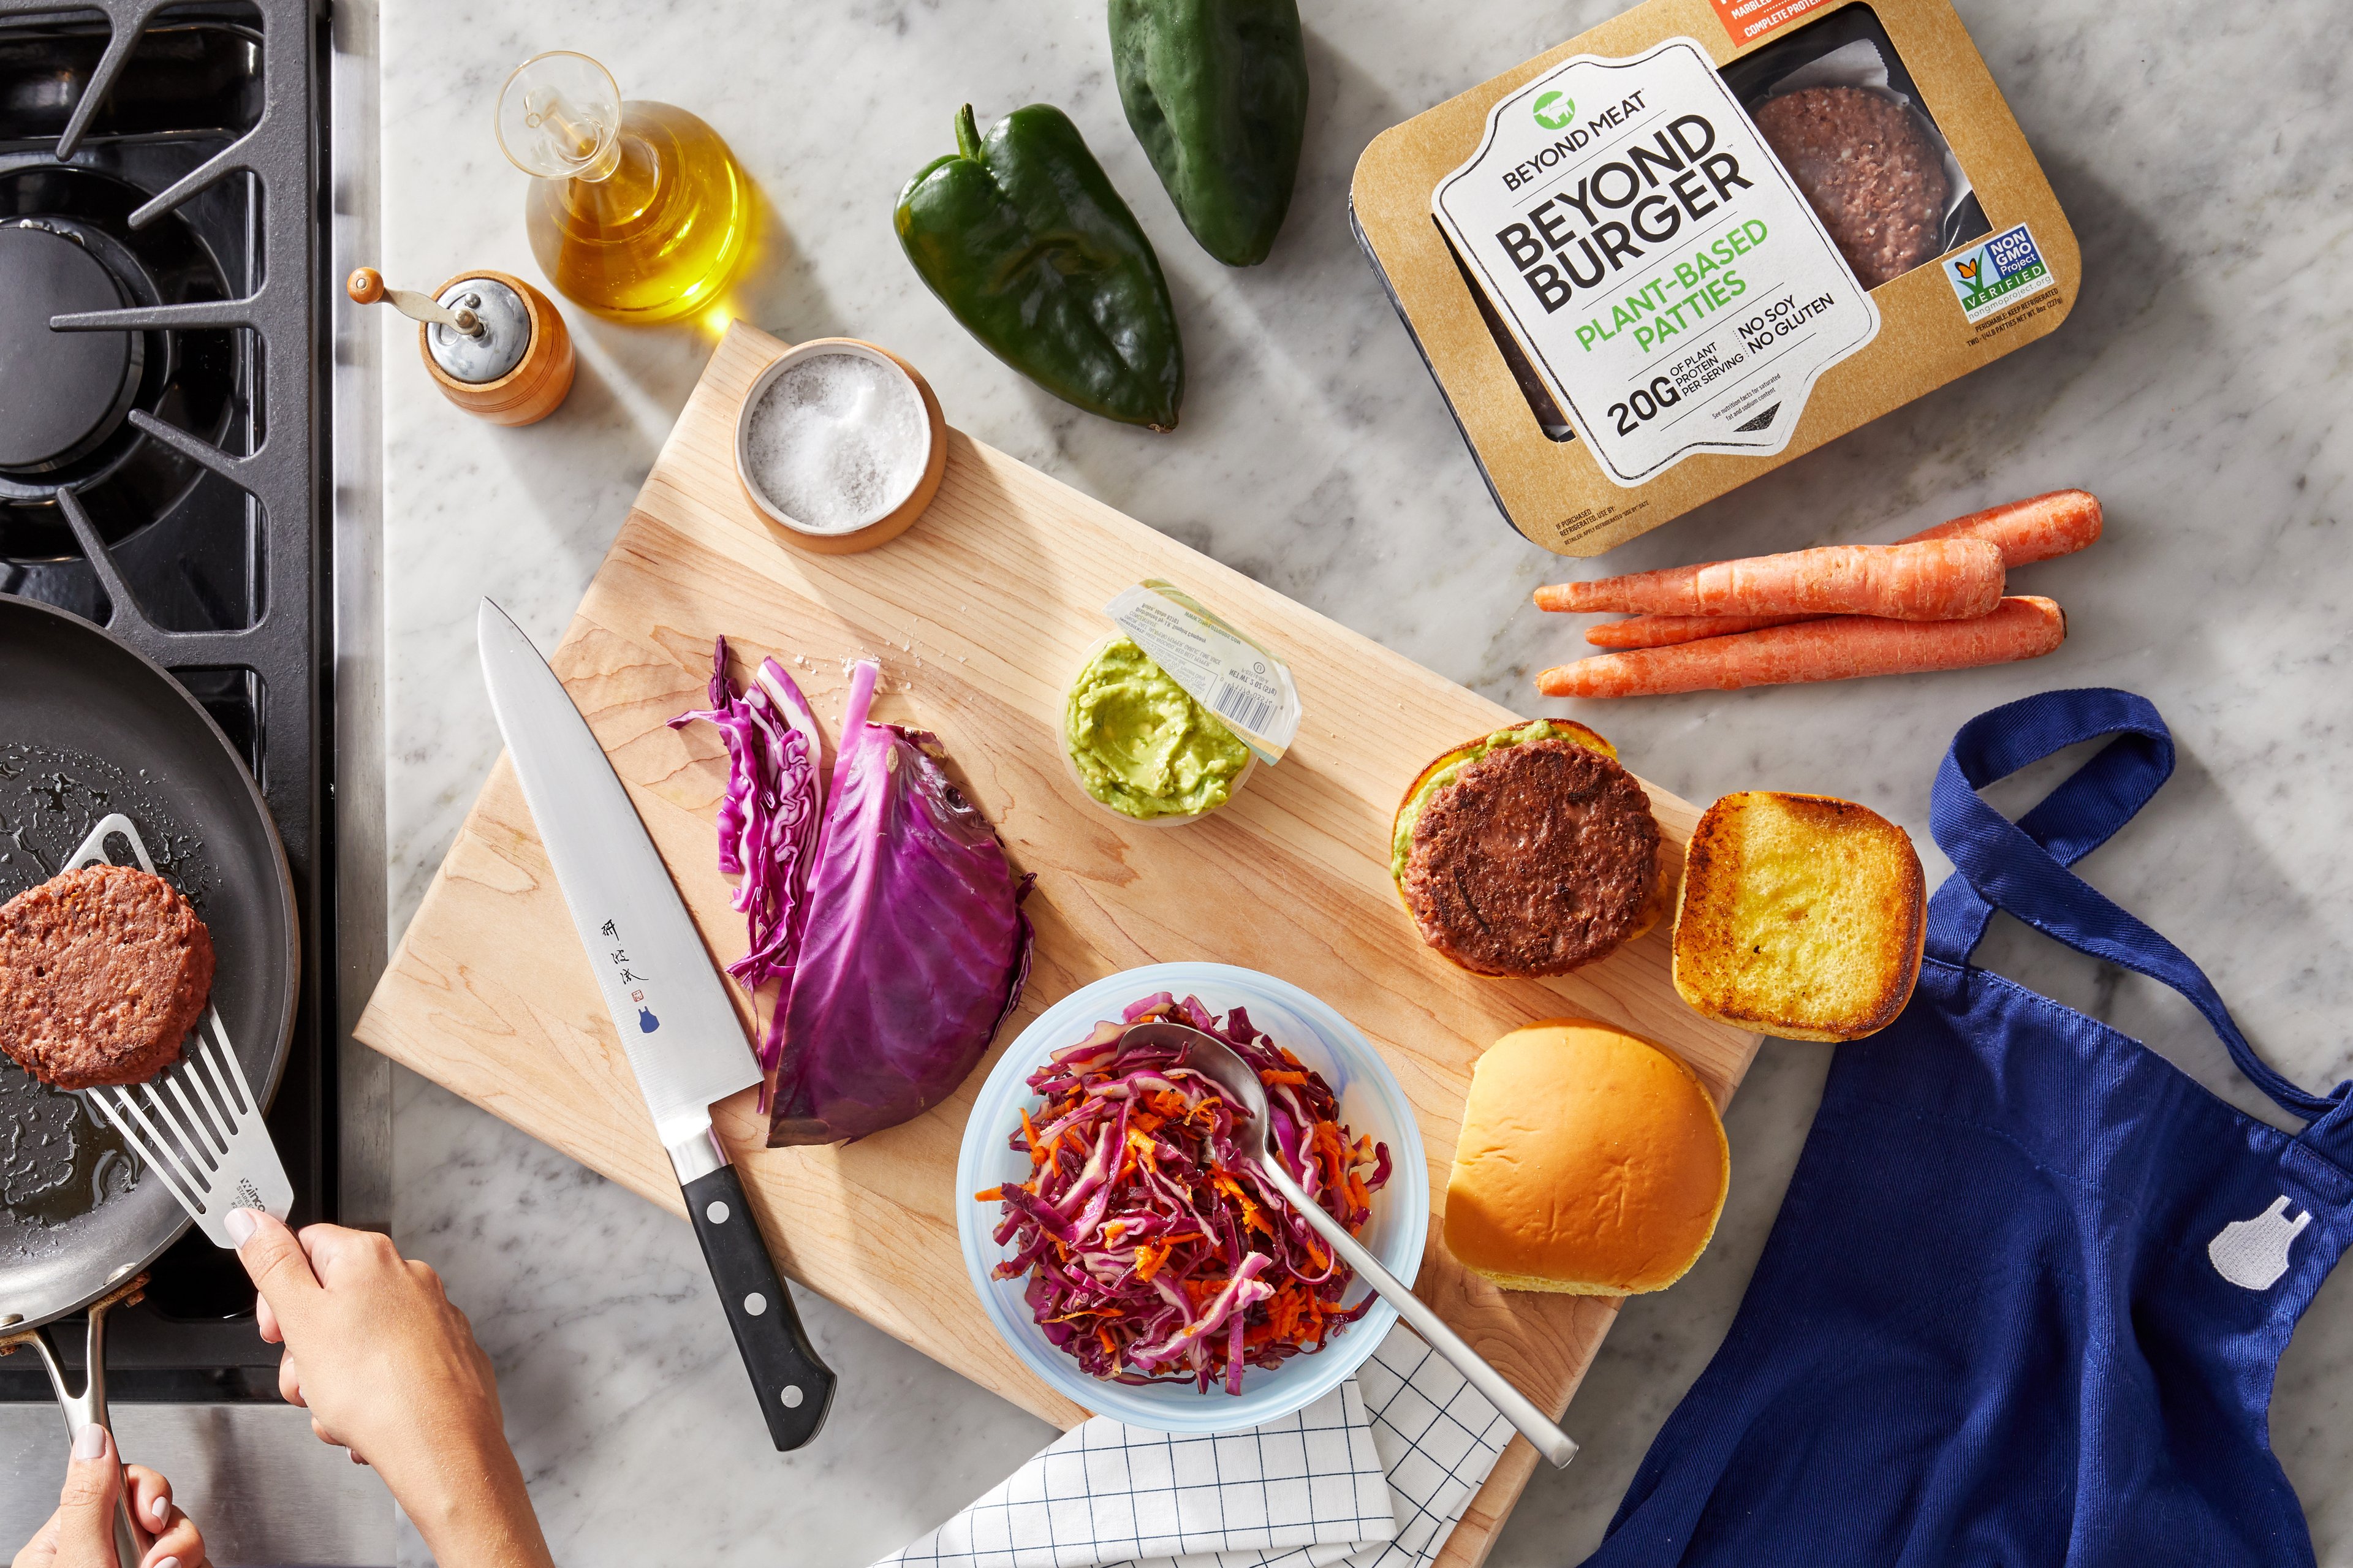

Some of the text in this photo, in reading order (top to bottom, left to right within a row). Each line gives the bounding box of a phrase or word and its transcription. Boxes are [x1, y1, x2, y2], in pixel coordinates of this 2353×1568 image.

[1743, 0, 1821, 37] COMPLETE PROTE
[1502, 90, 1645, 192] BEYOND MEAT
[1495, 115, 1715, 272] BEYOND
[1523, 153, 1754, 314] BURGER
[1990, 230, 2026, 256] NON
[1996, 242, 2032, 266] GMO
[1574, 219, 1767, 352] PLANT-BASED
[1967, 266, 2042, 307] VERIFIED
[2000, 254, 2037, 276] Project
[1633, 270, 1746, 353] PATTIES
[1737, 295, 1796, 339] NO SOY
[1968, 275, 2052, 320] nongmoproject.org
[1975, 288, 2059, 333] PERISHABLE: KEEP REFRIGERATED
[1747, 292, 1835, 354] NO GLUTEN
[1966, 337, 1980, 347] TWO
[1982, 328, 1996, 341] 1/4LB
[1996, 317, 2017, 333] PATTIES
[2017, 312, 2027, 323] NET
[2027, 309, 2037, 318] WT.
[2047, 297, 2063, 310] (227g)
[1670, 341, 1717, 376] OF PLANT
[1675, 355, 1719, 387] PROTEIN
[1681, 353, 1744, 397] PER SERVING
[1607, 376, 1682, 437] 20G
[1721, 399, 1741, 414] nutrition
[1740, 392, 1752, 402] facts
[1759, 373, 1781, 390] saturated
[1733, 408, 1742, 417] and
[1741, 398, 1759, 412] sodium
[1758, 387, 1776, 401] content
[1559, 515, 1598, 537] REFRIGERATED,
[1597, 509, 1608, 519] USE
[1561, 509, 1592, 528] PURCHASED
[1564, 532, 1583, 545] RETAILER:
[1583, 527, 1595, 537] APPLY
[1594, 513, 1623, 531] REFRIGERATED
[1638, 500, 1650, 509] DATE
[237, 1186, 254, 1209] STAINLE
